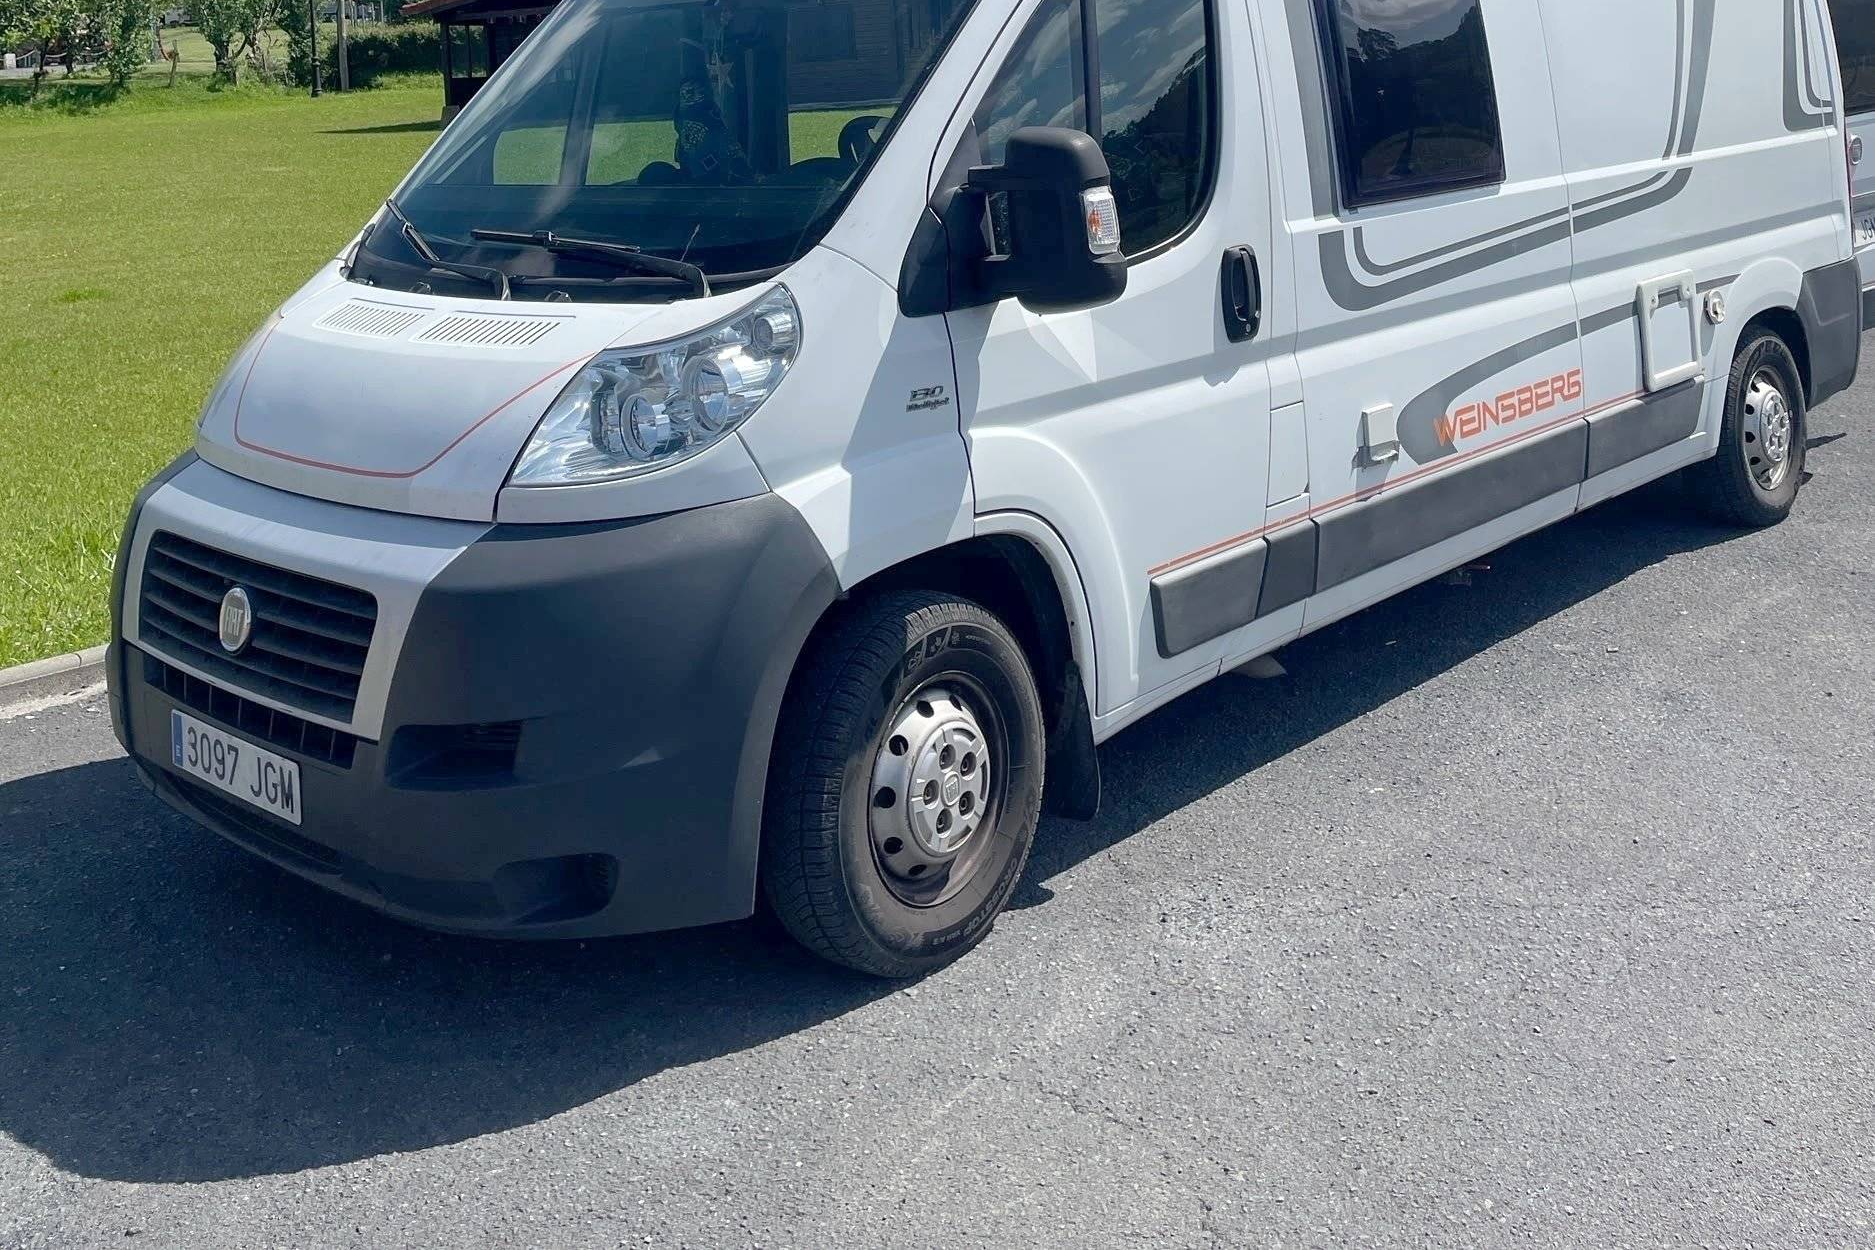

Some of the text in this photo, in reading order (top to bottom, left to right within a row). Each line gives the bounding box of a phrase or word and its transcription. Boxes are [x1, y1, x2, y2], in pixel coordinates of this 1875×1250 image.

[1433, 367, 1582, 447] WEINSBERG
[187, 726, 239, 786] 3097
[250, 756, 294, 814] JGM
